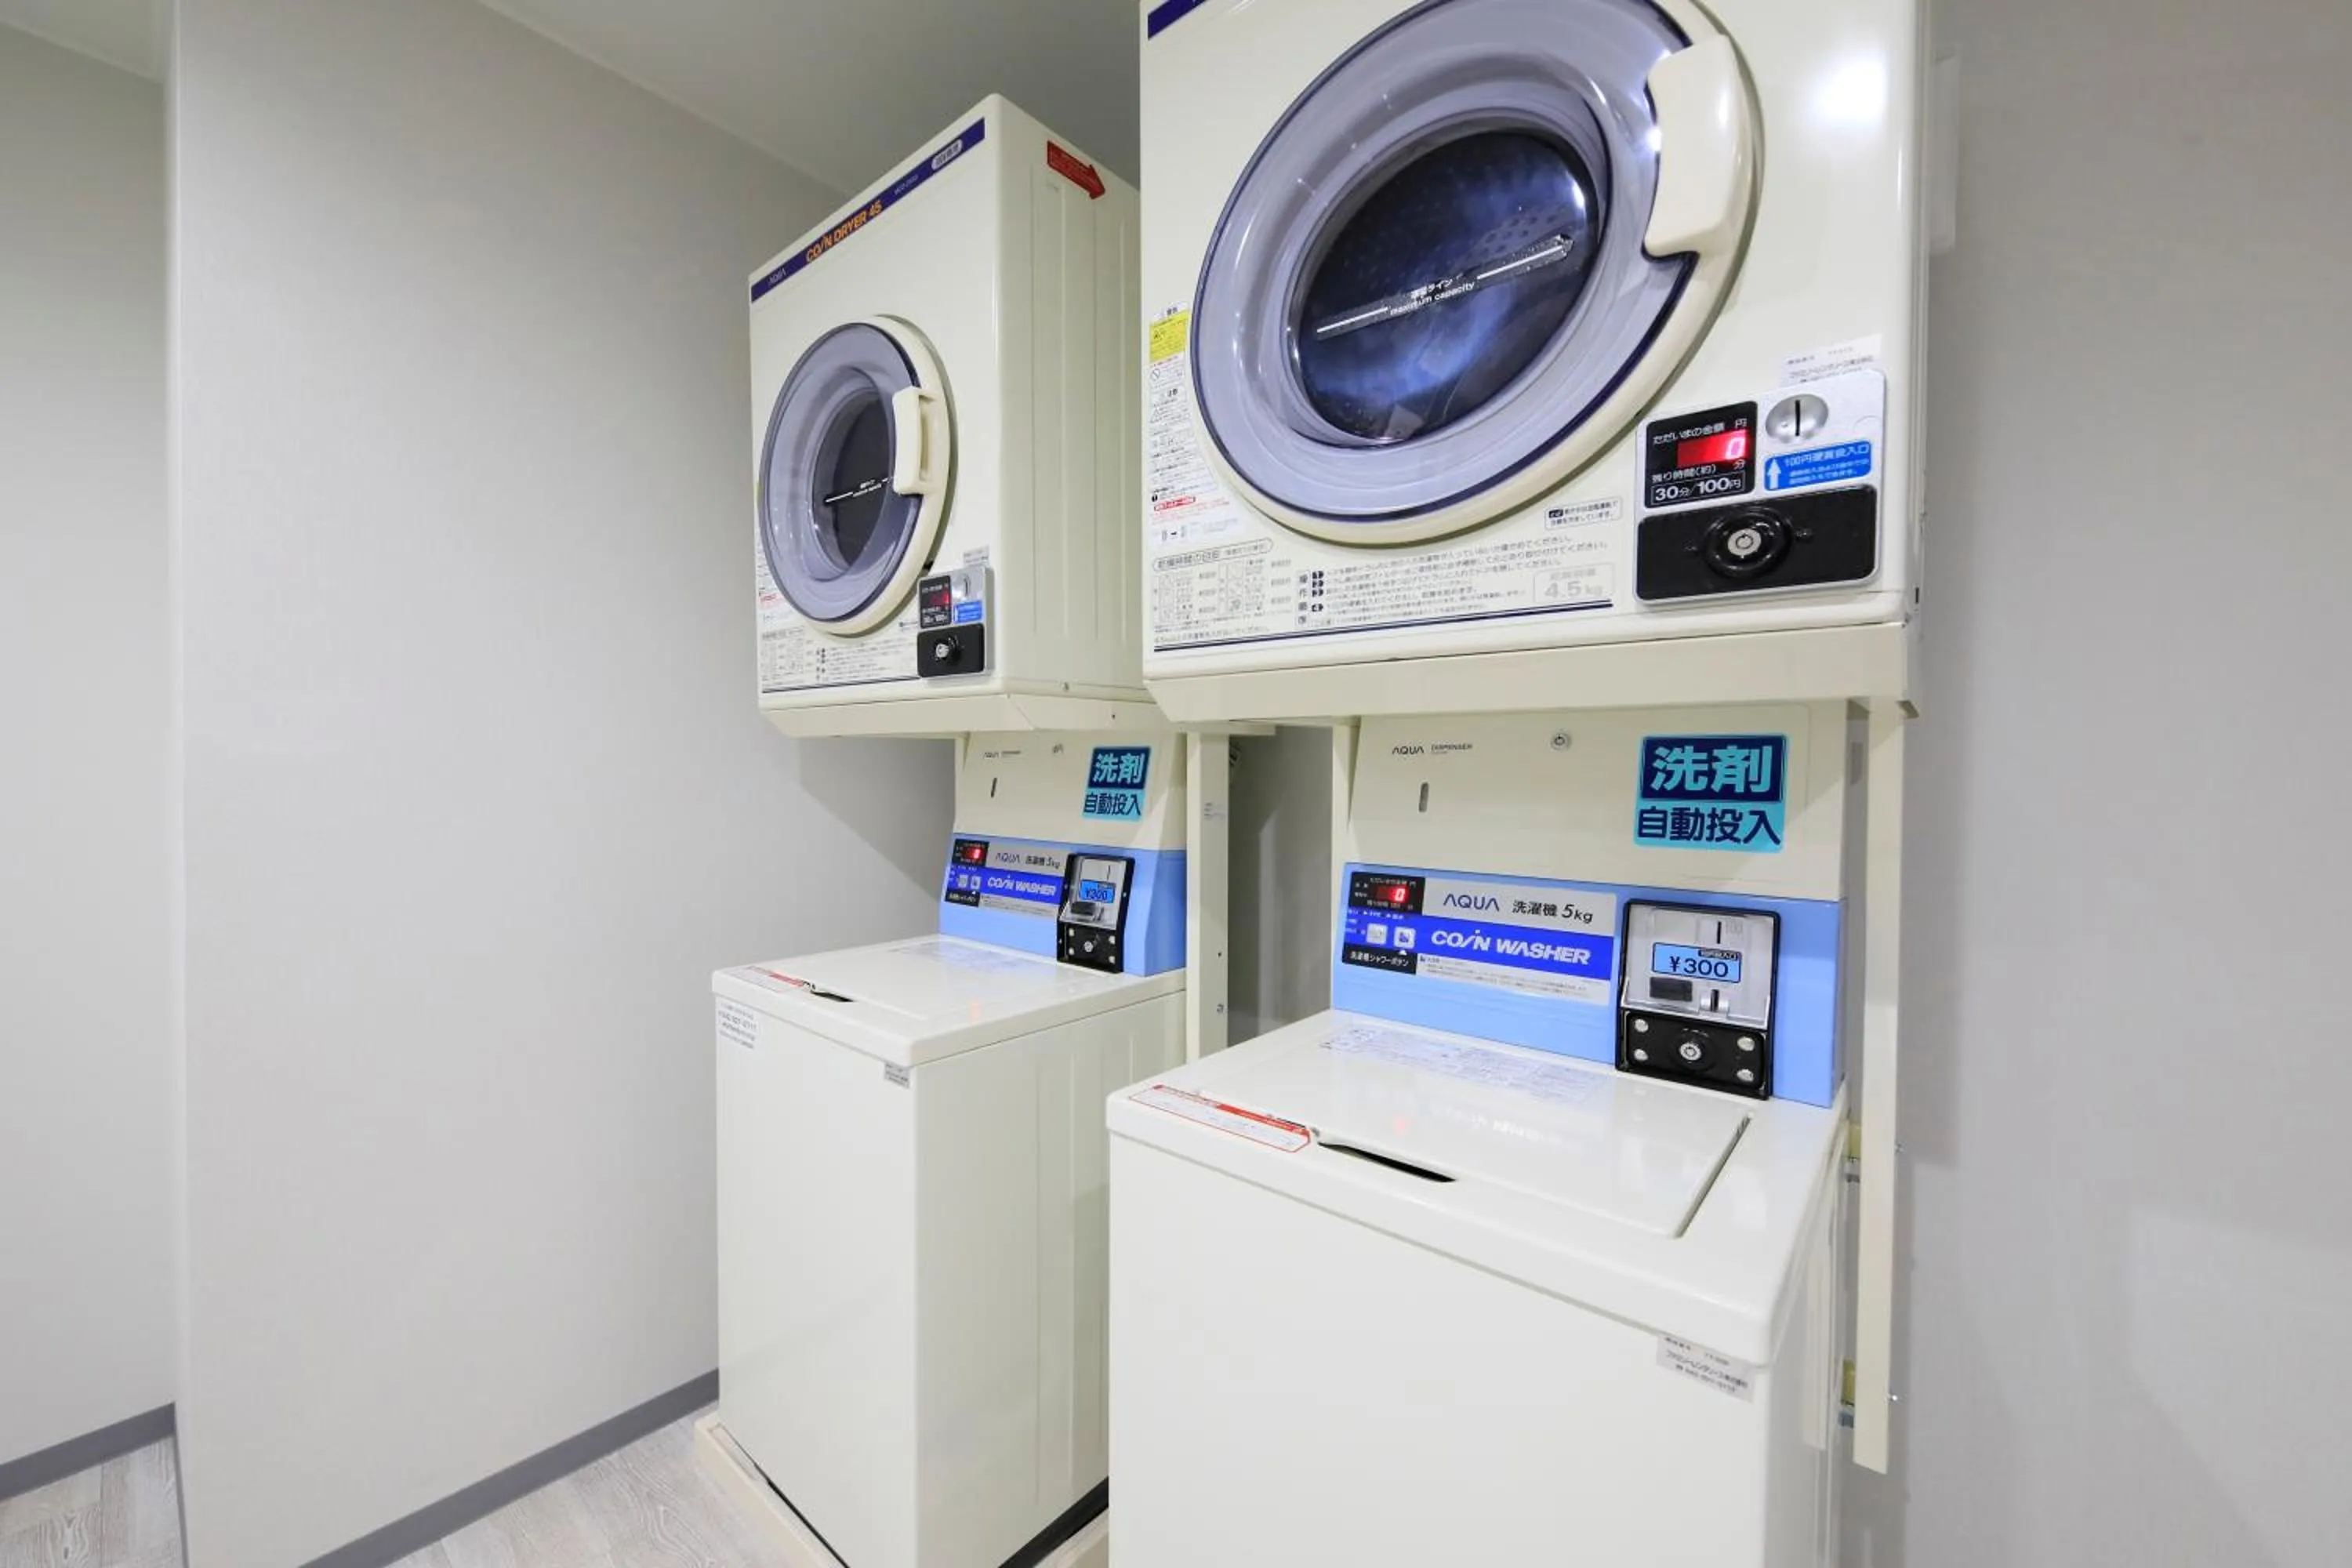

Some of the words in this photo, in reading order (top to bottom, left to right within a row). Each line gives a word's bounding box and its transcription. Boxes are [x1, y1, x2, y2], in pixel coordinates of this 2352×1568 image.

[834, 210, 867, 242] DRYER
[1434, 281, 1475, 300] capacity
[1726, 436, 1746, 460] 0
[1392, 746, 1425, 755] AQUA
[1093, 753, 1145, 784] 洗剤
[1651, 746, 1773, 793] 洗剤
[1083, 793, 1142, 815] 自動投入
[1638, 806, 1780, 845] 自動投入
[1015, 877, 1057, 896] WASHER
[1395, 887, 1406, 902] 0
[1443, 893, 1500, 912] AQUA
[1512, 899, 1558, 916] 洗濯機
[1561, 903, 1593, 924] 5kg
[1496, 938, 1591, 965] WASHER
[1670, 956, 1728, 978] ¥300
